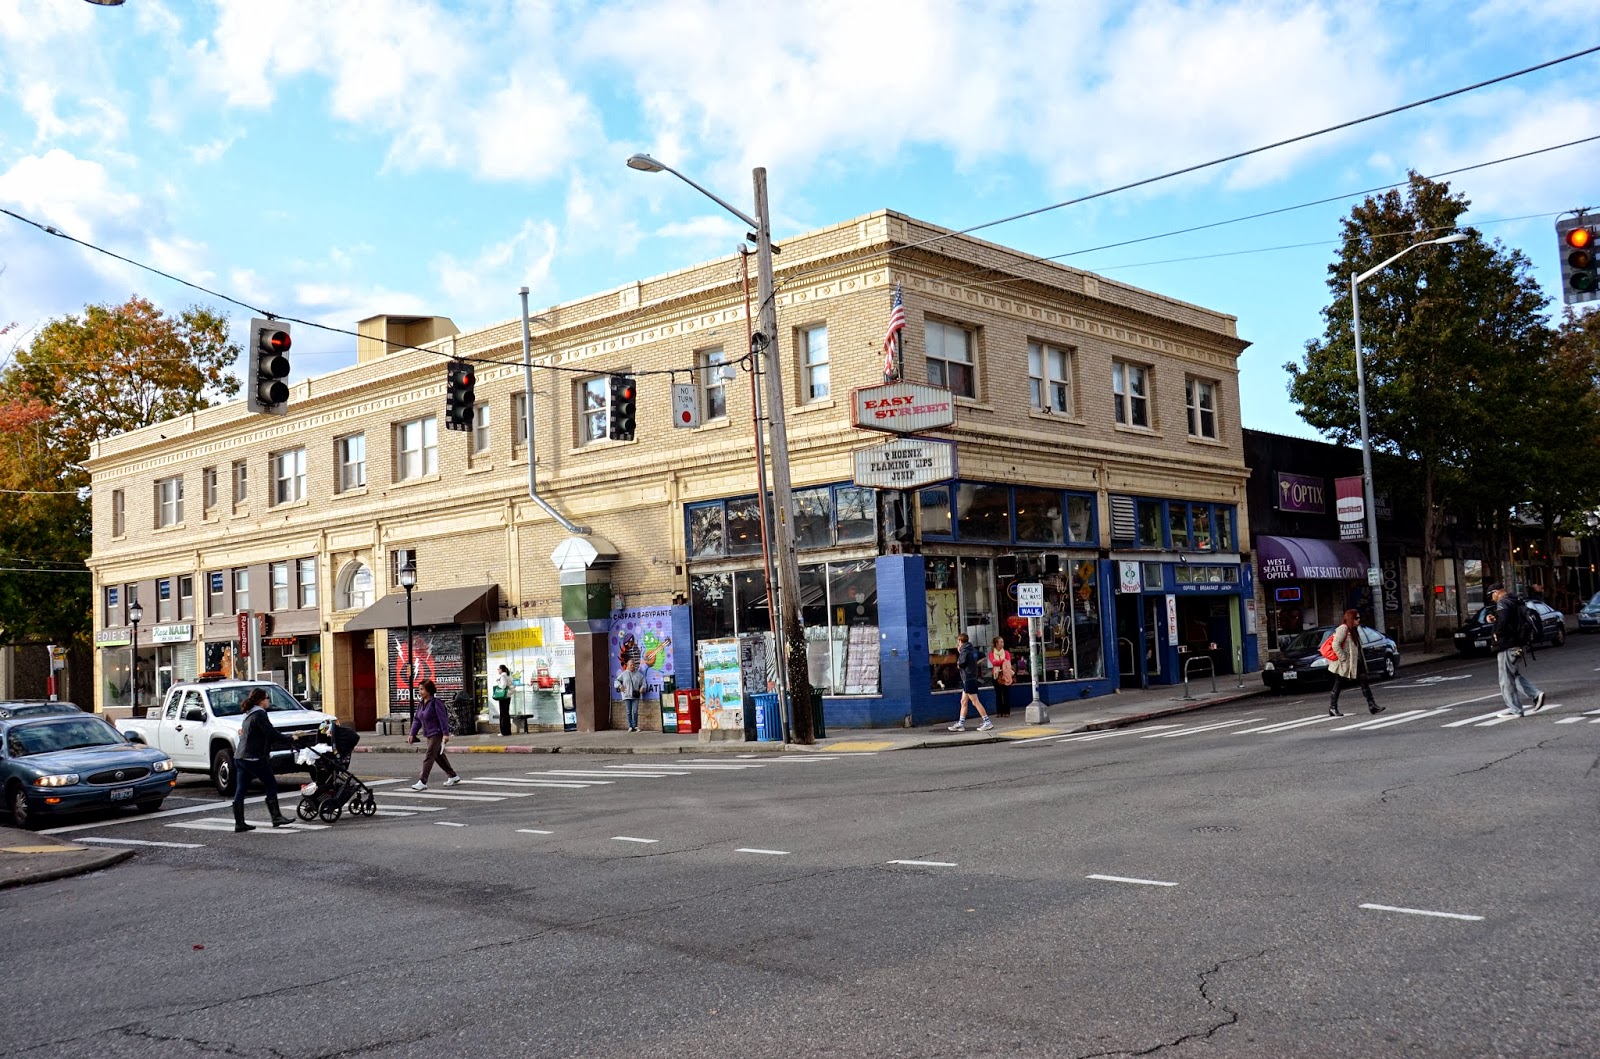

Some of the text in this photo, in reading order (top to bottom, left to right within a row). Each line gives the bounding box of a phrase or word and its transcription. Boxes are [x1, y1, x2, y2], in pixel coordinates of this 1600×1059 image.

[864, 396, 914, 409] EASY
[875, 403, 949, 418] STREET
[884, 448, 922, 461] PHOENIX
[871, 458, 933, 472] FLAMING LIPS
[891, 470, 915, 481] JUNIP
[1292, 482, 1323, 506] OPTIX
[1266, 558, 1286, 566] WEST
[1263, 564, 1291, 573] SEATTLE
[1303, 567, 1318, 577] WEST
[1320, 567, 1341, 577] SEATTLE
[1266, 571, 1288, 580] OPTIX
[1383, 560, 1399, 611] BOOKS
[613, 609, 672, 621] CASPAR BABYPANTS
[1021, 607, 1041, 615] WALK
[97, 630, 125, 642] EDIE'S
[153, 625, 190, 637] Rose NAILS
